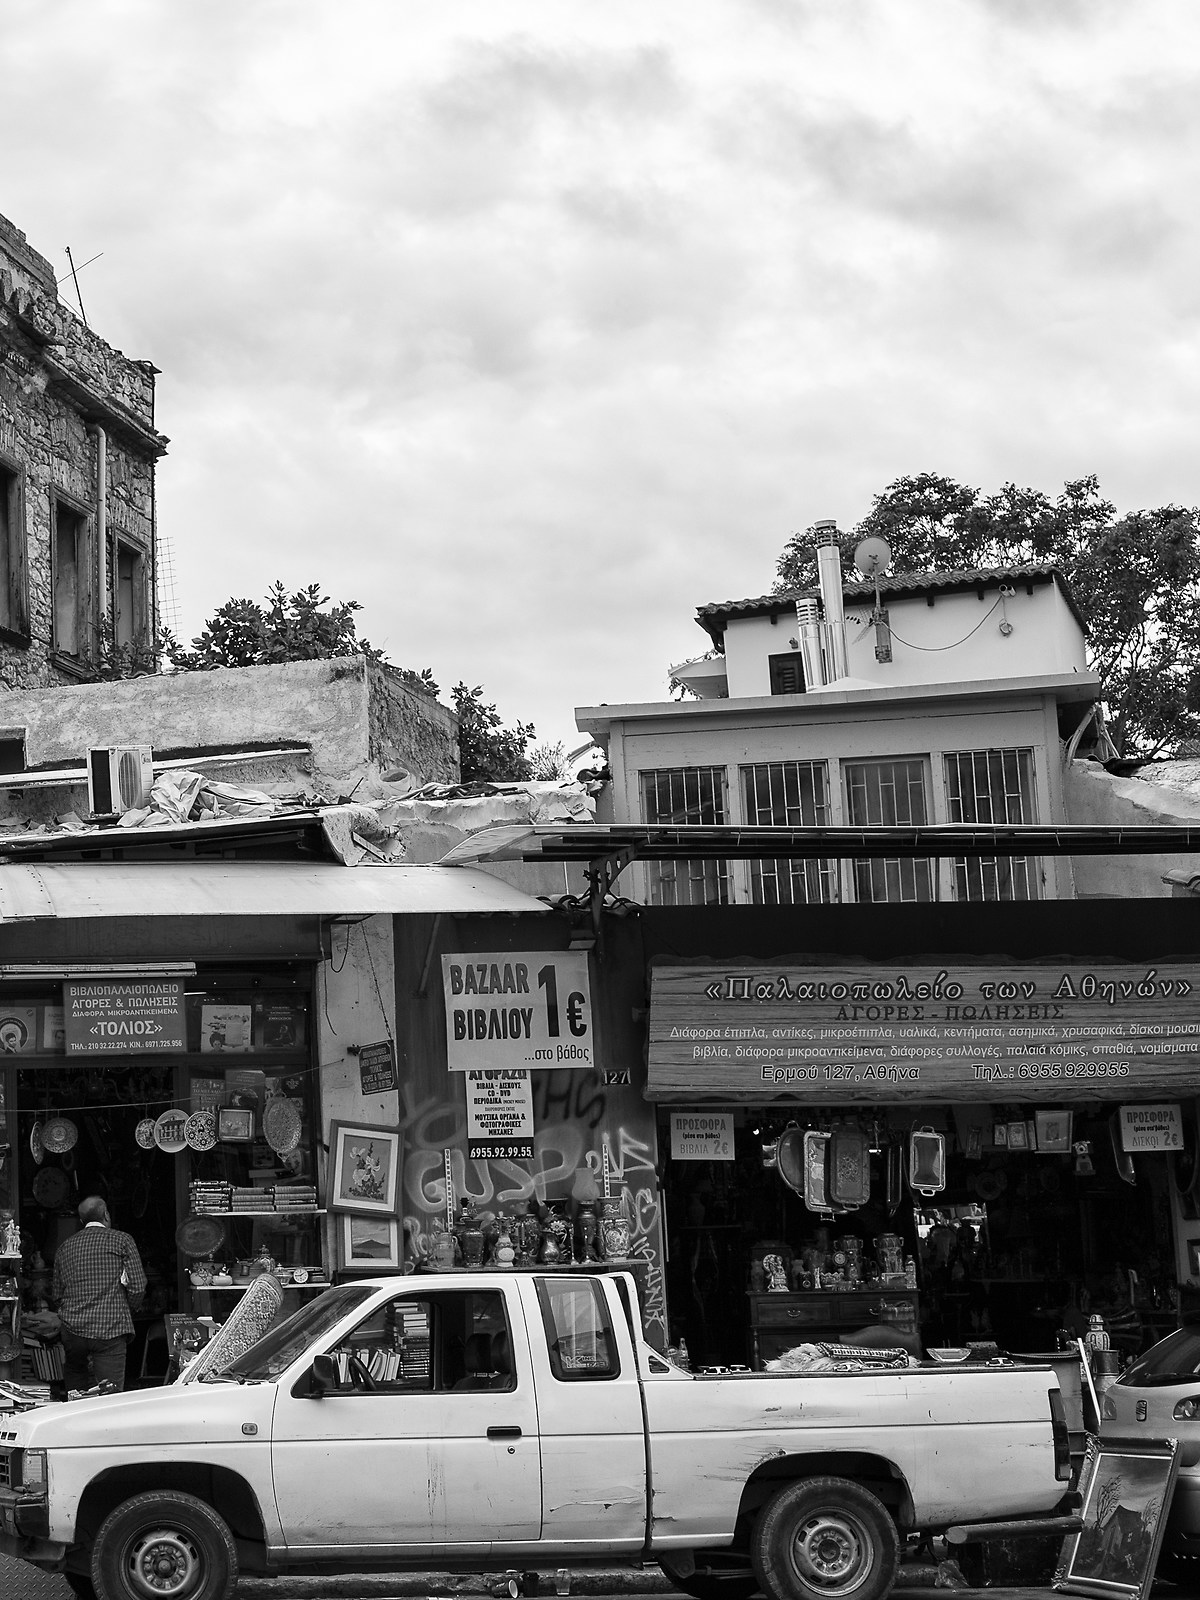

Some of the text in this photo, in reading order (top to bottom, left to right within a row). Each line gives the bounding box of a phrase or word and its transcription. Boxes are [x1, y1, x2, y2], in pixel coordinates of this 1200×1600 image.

[450, 963, 530, 995] BAZAAR
[70, 984, 179, 996] ΒΙΒΛΙΟΠΑΛΑΙΟΠΩΛΕΙΟ
[705, 968, 1193, 1006] «Παλαιοπωλείο των Αθηνών»
[72, 996, 178, 1009] ΑΓΟΡΕΣ & ΠΩΛΗΣΕΙΣ
[107, 1008, 179, 1016] ΜΙΚΡΟΑΝΤΙΚΕΙΜΕΝΑ
[835, 1005, 925, 1021] ΑΓΟΡΕΣ
[944, 1003, 1065, 1020] ΠΩΛΗΣΕΙΣ
[89, 1020, 163, 1036] «ΤΟΛΙΟΣ»
[453, 1007, 534, 1040] ΒΙΒΛΙΟΥ
[670, 1026, 721, 1040] Διάφορα
[724, 1026, 769, 1040] έπιπλα,
[772, 1027, 816, 1041] αντίκες,
[820, 1026, 896, 1041] μικροέπιπλα,
[899, 1026, 940, 1039] υαλικά,
[943, 1025, 1005, 1040] κεντήματα,
[1008, 1024, 1058, 1039] ασημικά,
[1061, 1023, 1126, 1039] χρυσαφικά,
[1129, 1022, 1164, 1036] δίσκοι
[88, 1042, 99, 1050] 210
[692, 1042, 1198, 1059] βιβλία, διάφορα μικροαντικείμενα, διάφορες συλλογές, παλαιά κόμικς, σπαθιά, νομίσματα
[524, 1044, 590, 1062] ...στο βάθος
[761, 1061, 1130, 1083] Ερμού 127, Αθήνα Τηλ.: 6955 929955
[476, 1082, 495, 1090] ΒΙΒΛΙΑ
[499, 1082, 522, 1090] ΔΙΣΚΟΥΣ
[487, 1089, 496, 1097] CD
[500, 1089, 511, 1097] DVD
[473, 1097, 502, 1105] ΠΕΡΙΟΔΙΚΑ
[474, 1112, 527, 1121] ΜΟΥΣΙΚΑ ΟΡΓΑΝΑ &
[1126, 1110, 1175, 1124] ΠΡΟΣΦΟΡΑ
[479, 1120, 522, 1129] ΦΩΤΟΓΡΑΦΙΚΕΣ
[676, 1118, 727, 1131] ΠΡΟΣΦΟΡΑ
[488, 1128, 514, 1136] ΜΗΧΑΝΕΣ
[1132, 1135, 1159, 1147] ΔΙΣΚΟΙ
[470, 1146, 532, 1158] 6955.92.99.55
[680, 1143, 709, 1154] ΒΙΒΛΙΑ
